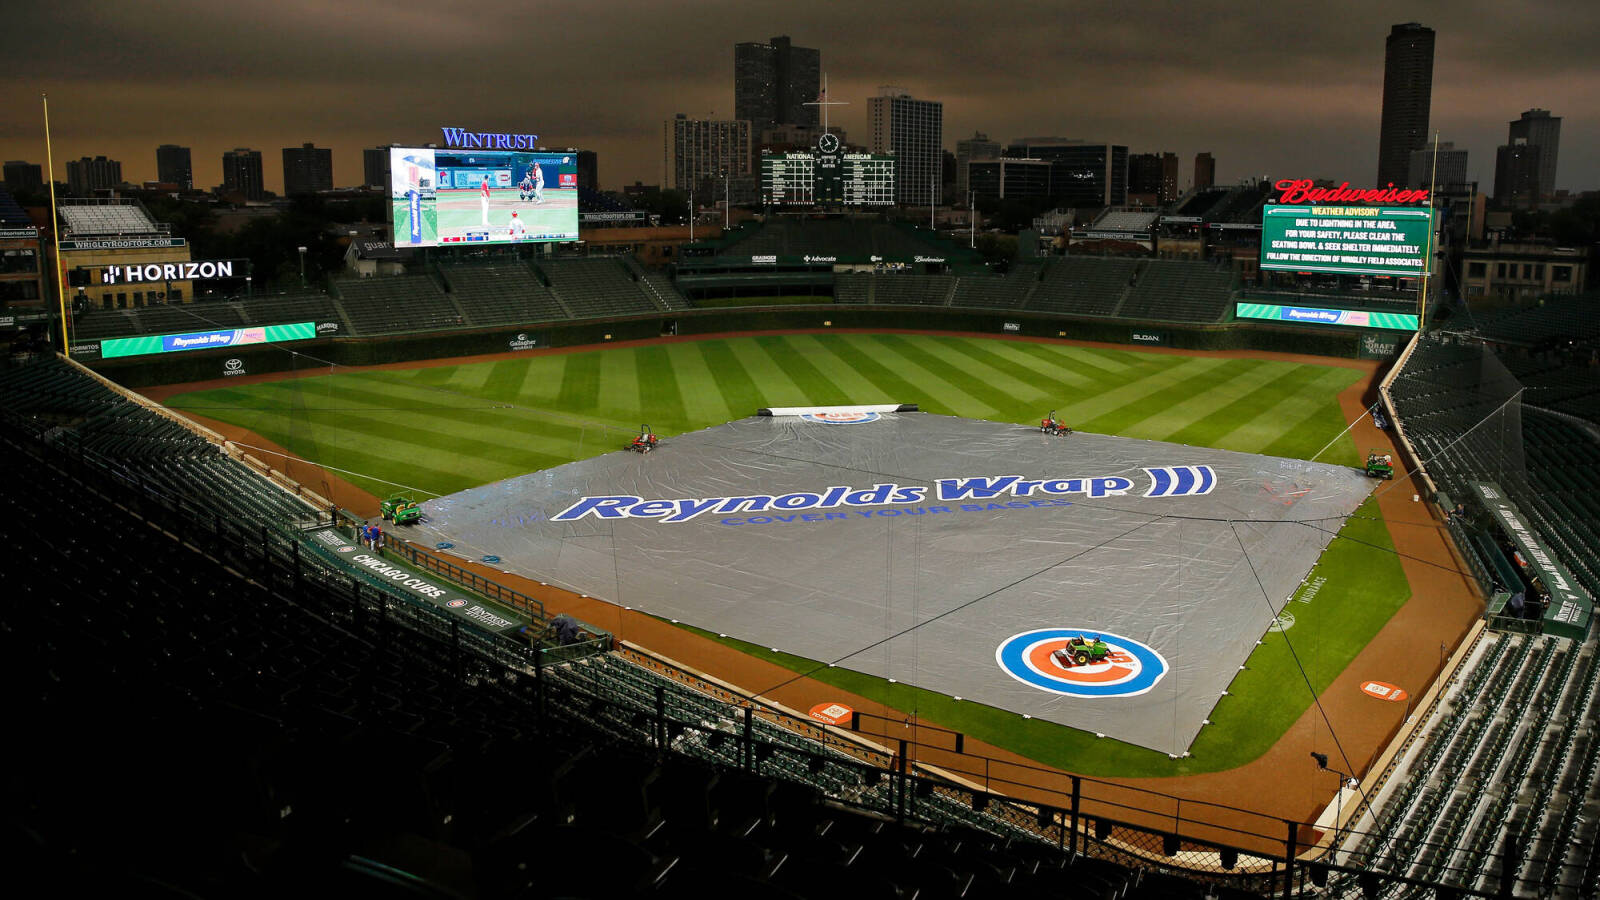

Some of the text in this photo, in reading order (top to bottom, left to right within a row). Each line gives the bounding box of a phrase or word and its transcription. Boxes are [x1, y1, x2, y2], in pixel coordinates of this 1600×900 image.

[441, 127, 537, 149] WINTRUST
[1275, 179, 1429, 203] Budweiser
[1312, 207, 1380, 216] WEATHER ADVISORY
[1296, 219, 1396, 230] DUE TO LIGHTNING IN THE AREA,
[1286, 230, 1405, 241] FOR YOUR SAFETY, PLEASE CLEAR THE
[74, 240, 172, 248] WRIGLEYROOFTOPS.COM
[1272, 241, 1420, 254] SEATING BOWL & SEEK SHELTER IMMEDIATELY.
[1301, 254, 1331, 262] DIRECTION
[1341, 255, 1366, 264] WRIGLEY
[1368, 257, 1384, 265] FIELD
[126, 261, 233, 282] HORIZON
[172, 334, 231, 347] Reynolds Wrap
[1368, 341, 1395, 349] DRAFT
[224, 368, 245, 376] TOYOTA
[550, 476, 1134, 524] Reynolds Wrap
[721, 498, 1072, 526] COVER YOUR BASES
[352, 554, 446, 598] CHICAGO CUBS
[812, 712, 836, 724] TOYOTA
